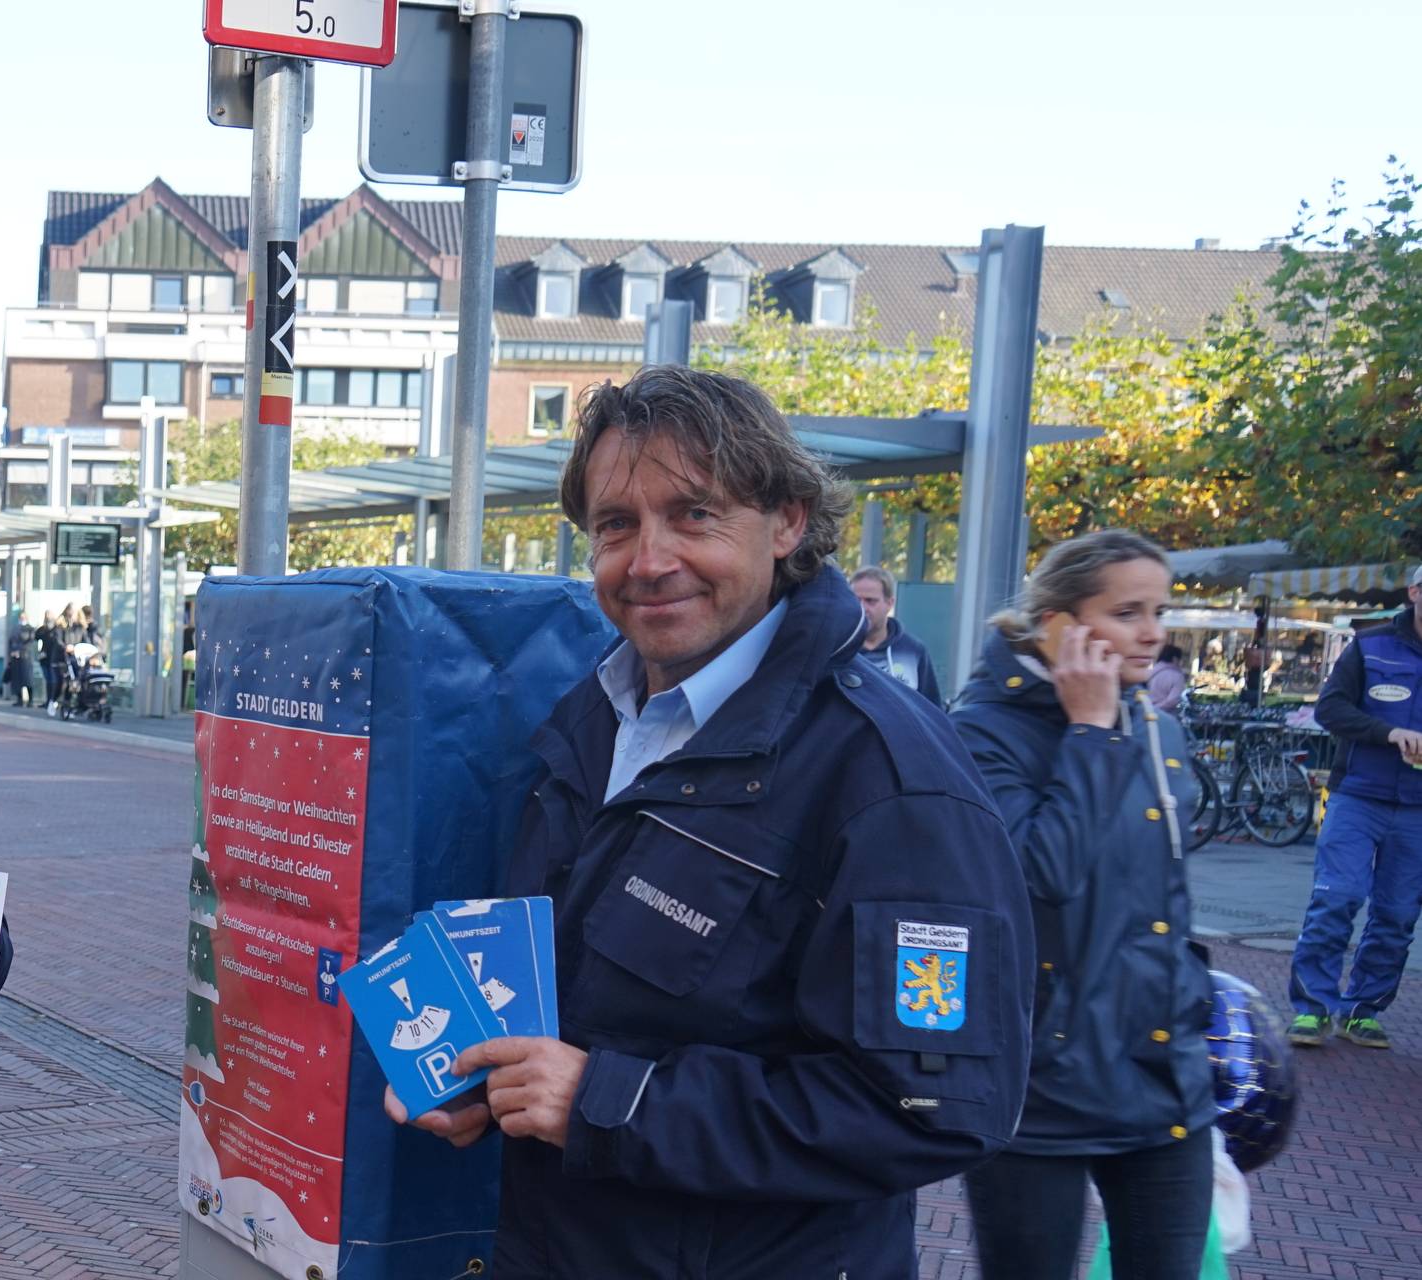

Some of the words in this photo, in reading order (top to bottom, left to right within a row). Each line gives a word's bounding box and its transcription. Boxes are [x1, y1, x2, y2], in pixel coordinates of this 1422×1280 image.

[236, 692, 270, 714] STADT
[271, 697, 324, 722] GELDERN
[210, 782, 220, 796] An
[221, 784, 238, 801] den
[239, 787, 276, 813] Samstagen
[277, 801, 291, 814] vor
[293, 799, 357, 826] Weihnachten
[211, 812, 235, 829] sowie
[235, 819, 245, 831] an
[245, 820, 288, 843] Heiligabend
[290, 831, 310, 848] und
[312, 835, 353, 857] Silvester
[224, 842, 258, 864] verzichtet
[258, 852, 271, 867] die
[271, 855, 294, 874] Stadt
[295, 860, 332, 883] Geldern
[239, 875, 252, 890] auf
[255, 877, 311, 908] Parkgebühren.
[624, 875, 718, 937] ORDNUNGSAMT
[221, 913, 256, 937] Stattdessen
[256, 924, 265, 938] ist
[265, 928, 275, 943] die
[276, 931, 315, 957] Parkscheibe
[446, 925, 503, 940] NKUNFTSZEIT
[900, 923, 928, 936] Stadt
[928, 926, 968, 940] Geldern
[901, 935, 964, 949] ORDNUNGSAMT
[245, 942, 283, 964] auszulegen!
[367, 952, 413, 984] ANKUNFTSZEIT
[221, 954, 274, 984] Höchstparkdauer
[275, 976, 280, 986] 2
[280, 978, 309, 997] Stunden
[484, 989, 494, 1001] 8
[222, 1014, 231, 1025] Die
[231, 1017, 247, 1031] Stadt
[248, 1022, 267, 1038] Geldern
[267, 1030, 290, 1047] wünscht
[396, 1023, 404, 1038] 9
[408, 1023, 422, 1039] 10
[420, 1014, 435, 1030] 11
[224, 1042, 235, 1054] und
[267, 1045, 287, 1061] Einkauf
[424, 1051, 452, 1093] P
